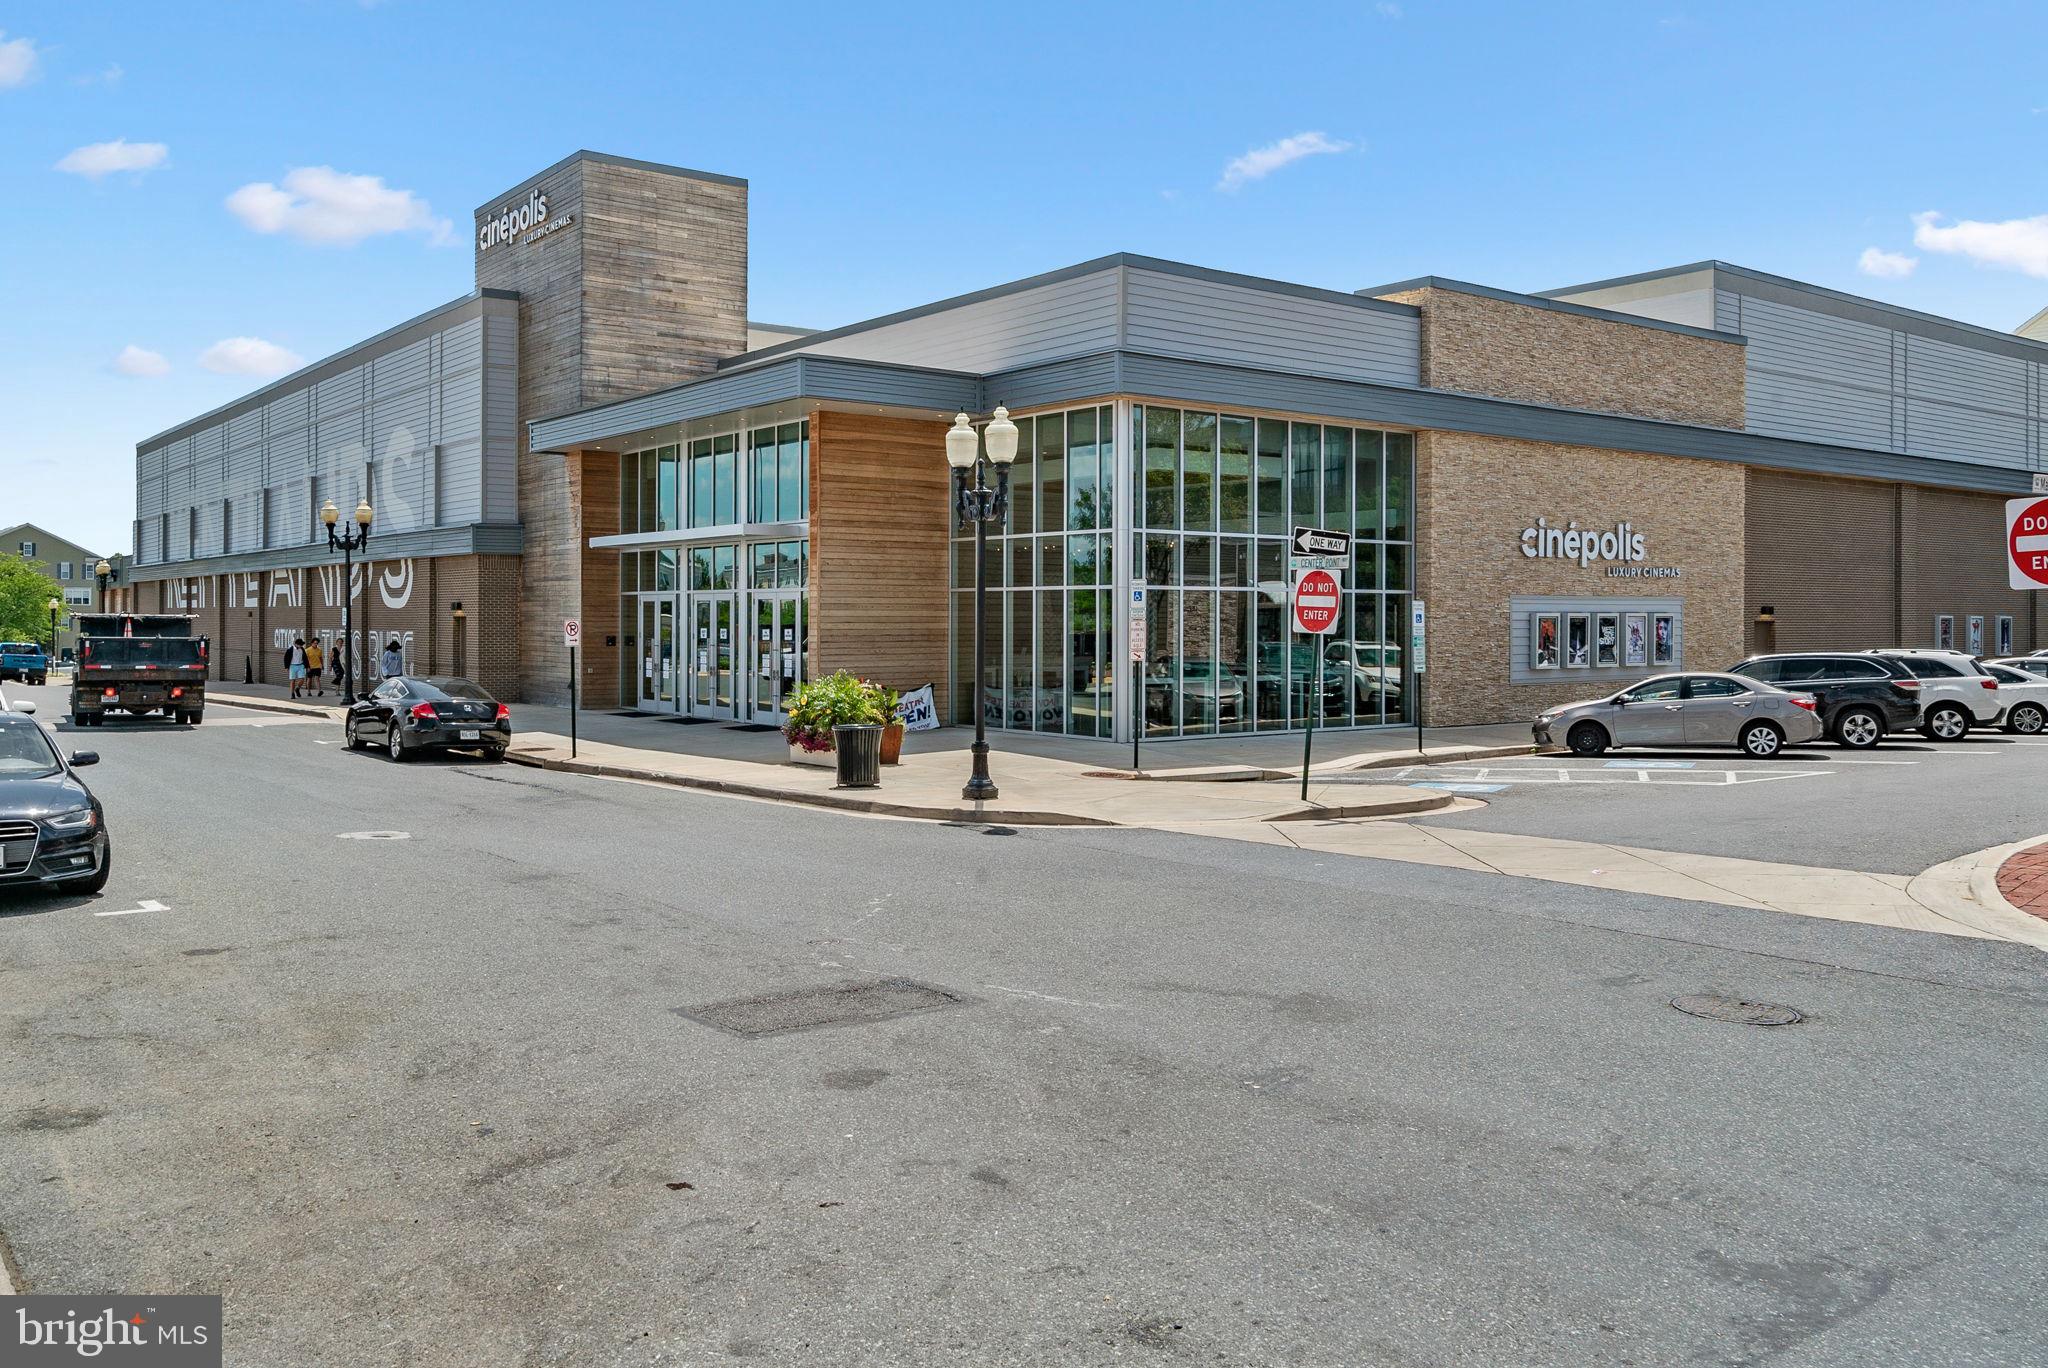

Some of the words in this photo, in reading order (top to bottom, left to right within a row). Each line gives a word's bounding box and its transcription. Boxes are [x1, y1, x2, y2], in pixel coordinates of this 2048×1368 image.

[480, 189, 547, 250] cinépolis
[523, 228, 544, 245] LUXURY
[2023, 516, 2048, 531] DO
[1309, 537, 1325, 548] ONE
[1327, 539, 1343, 550] WAY
[1520, 517, 1646, 569] cinépolis
[1300, 558, 1323, 568] CENTER
[1325, 557, 1340, 568] POINT
[1607, 567, 1643, 578] LUXURY
[1643, 567, 1681, 578] CINEMAS
[1302, 582, 1314, 593] DO
[1317, 582, 1334, 593] NOT
[1303, 610, 1329, 621] ENTER
